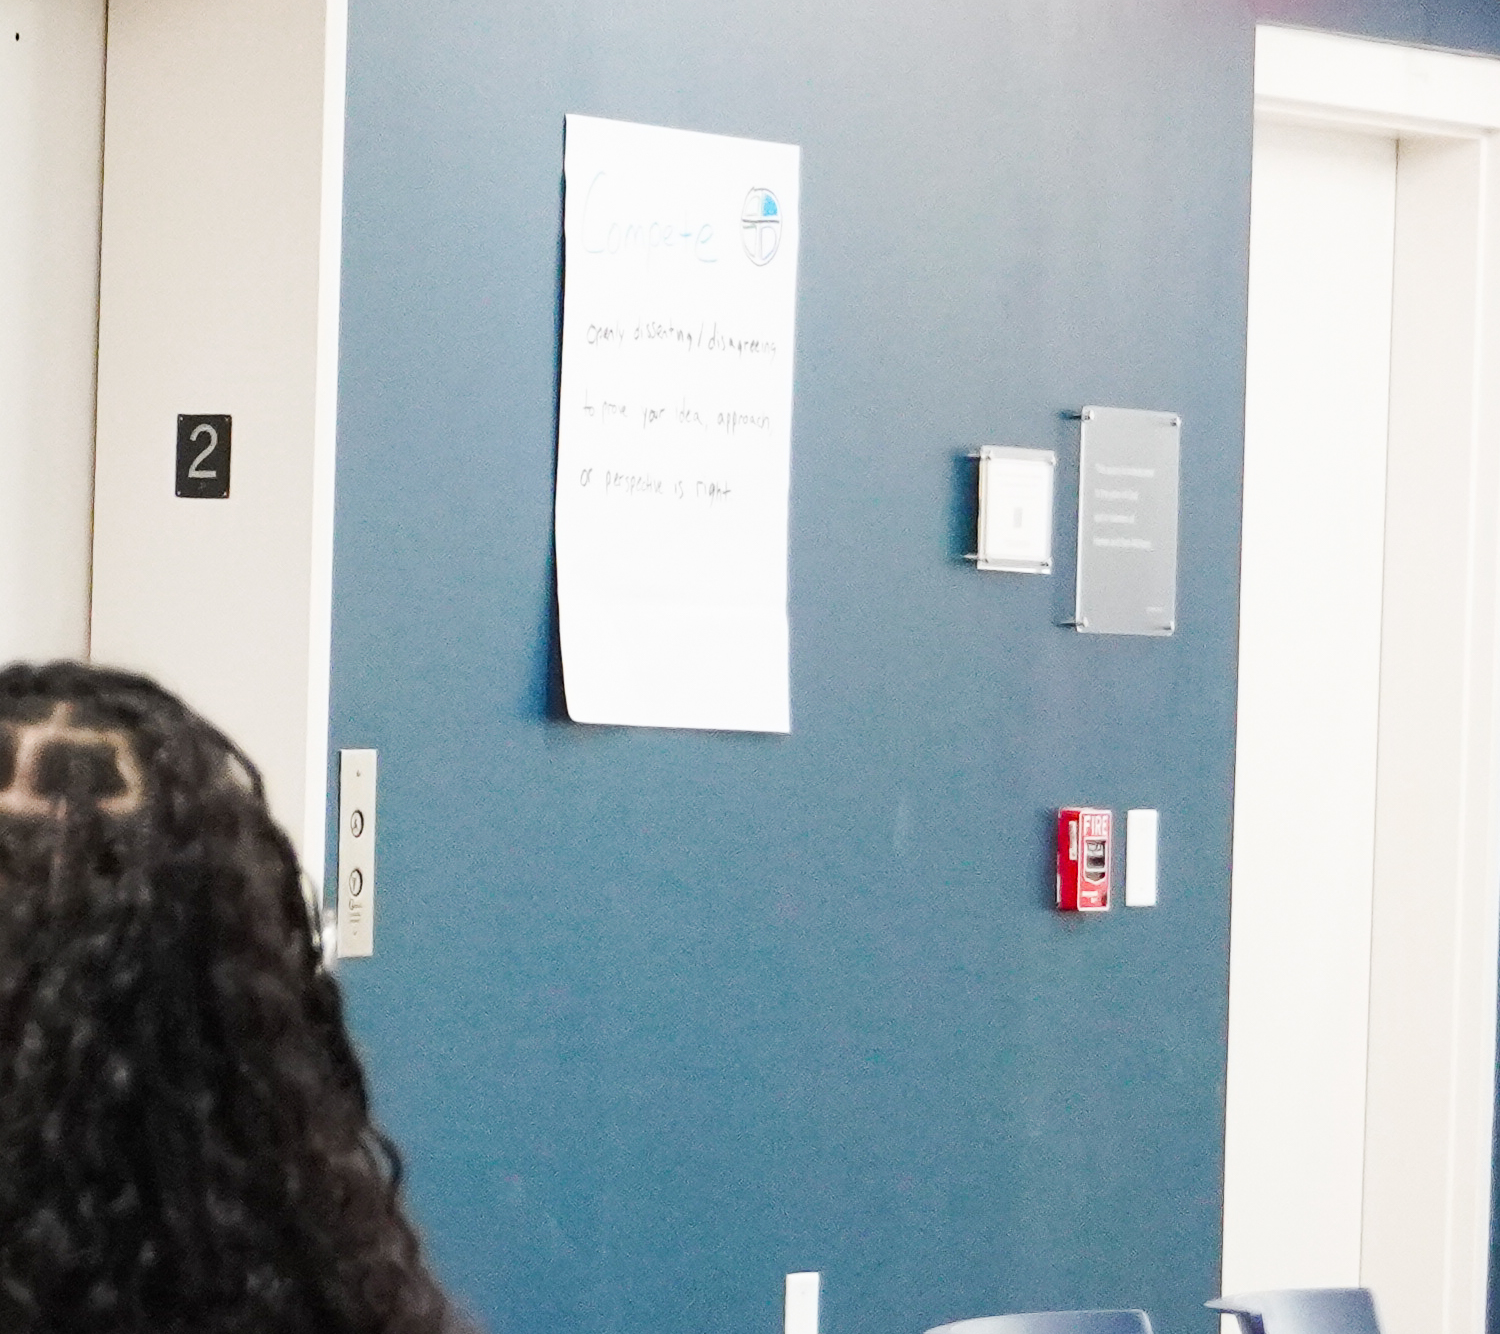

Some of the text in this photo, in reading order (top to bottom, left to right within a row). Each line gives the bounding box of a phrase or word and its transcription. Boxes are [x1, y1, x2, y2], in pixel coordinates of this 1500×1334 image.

[581, 170, 719, 273] Compete
[583, 388, 596, 417] to
[187, 422, 218, 478] 2
[1084, 816, 1108, 836] FIRE
